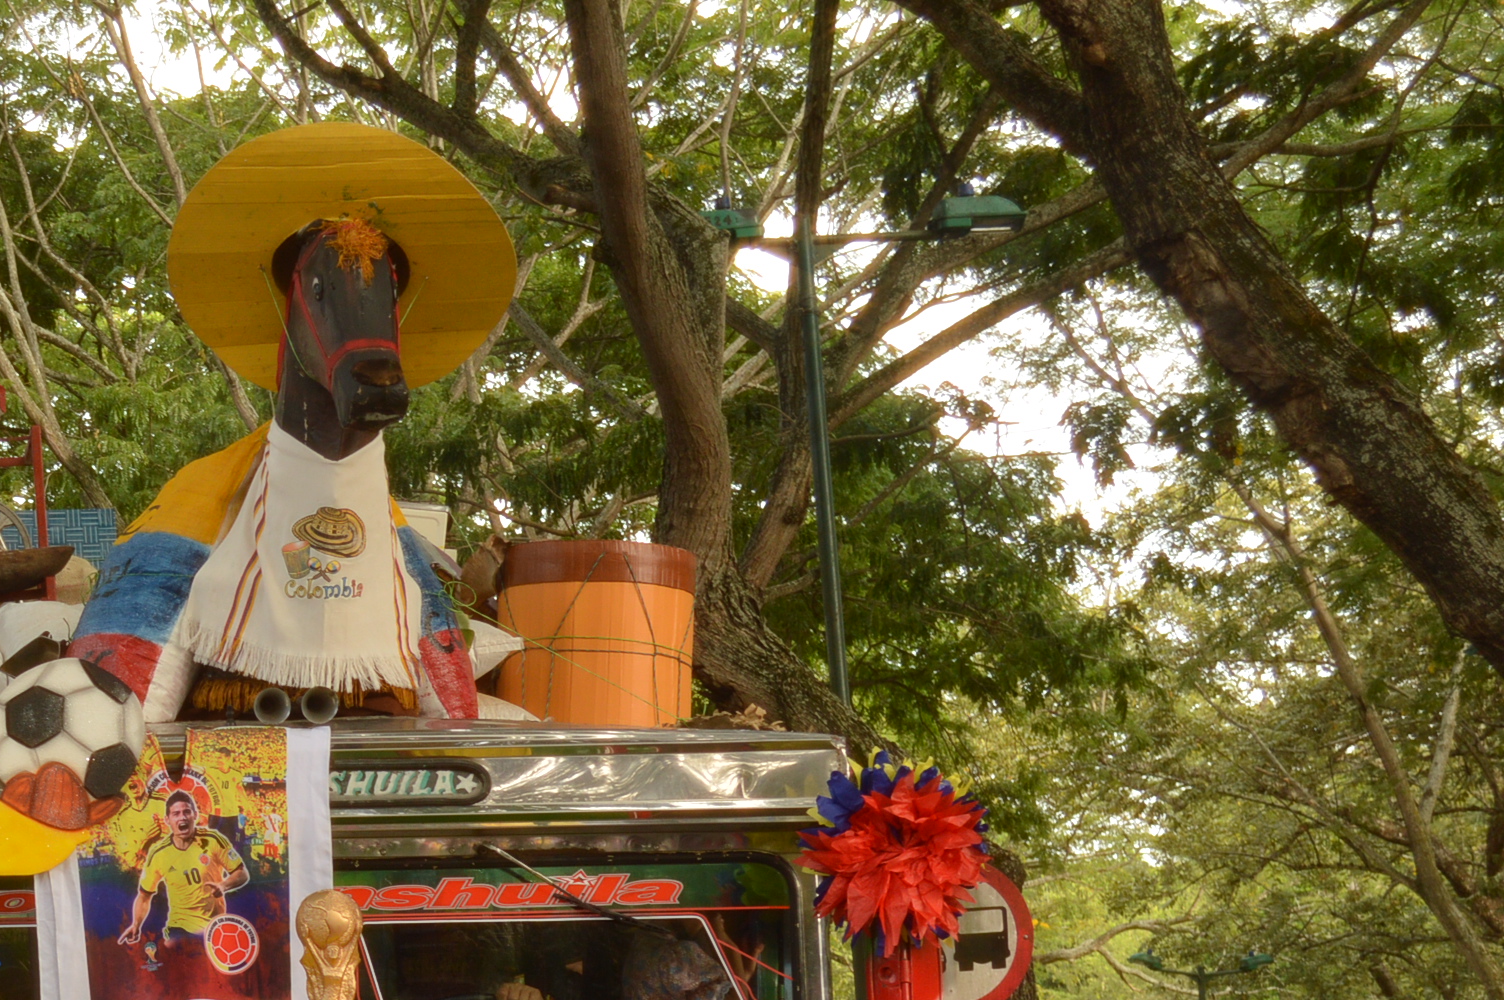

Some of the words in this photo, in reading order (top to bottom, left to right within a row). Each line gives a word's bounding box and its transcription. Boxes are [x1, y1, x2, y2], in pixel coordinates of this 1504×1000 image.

[284, 576, 363, 599] Colombia
[329, 770, 456, 795] SHUILA
[183, 867, 202, 886] 10
[333, 869, 684, 911] nshuila
